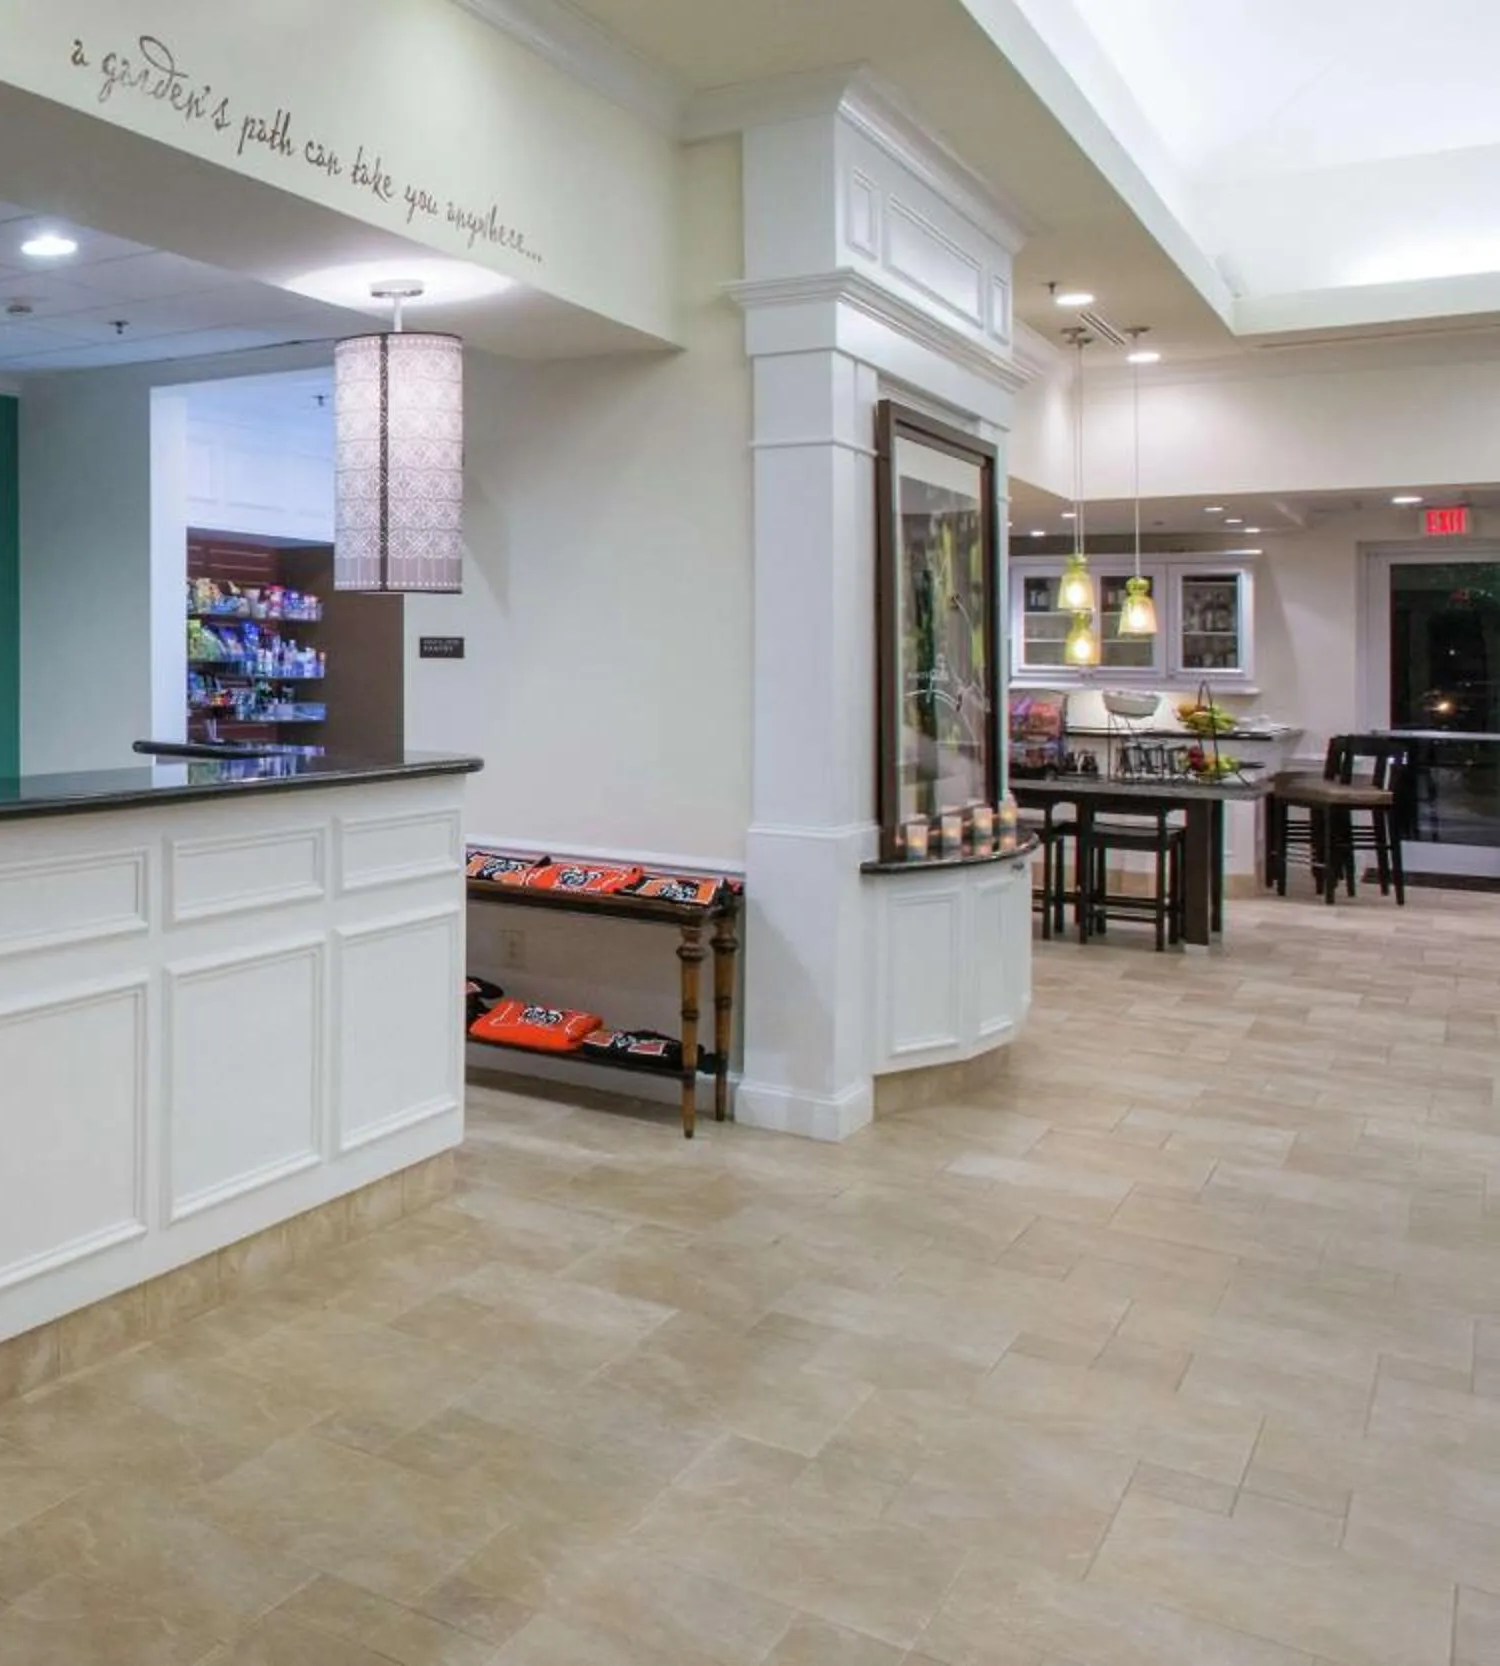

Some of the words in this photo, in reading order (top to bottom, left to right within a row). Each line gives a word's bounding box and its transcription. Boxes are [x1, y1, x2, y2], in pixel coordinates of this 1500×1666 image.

[71, 38, 90, 67] a
[97, 35, 231, 131] garden's
[237, 108, 294, 156] path
[304, 140, 342, 177] can
[350, 145, 394, 204] take
[404, 184, 438, 225] you
[1426, 508, 1466, 534] EXIT
